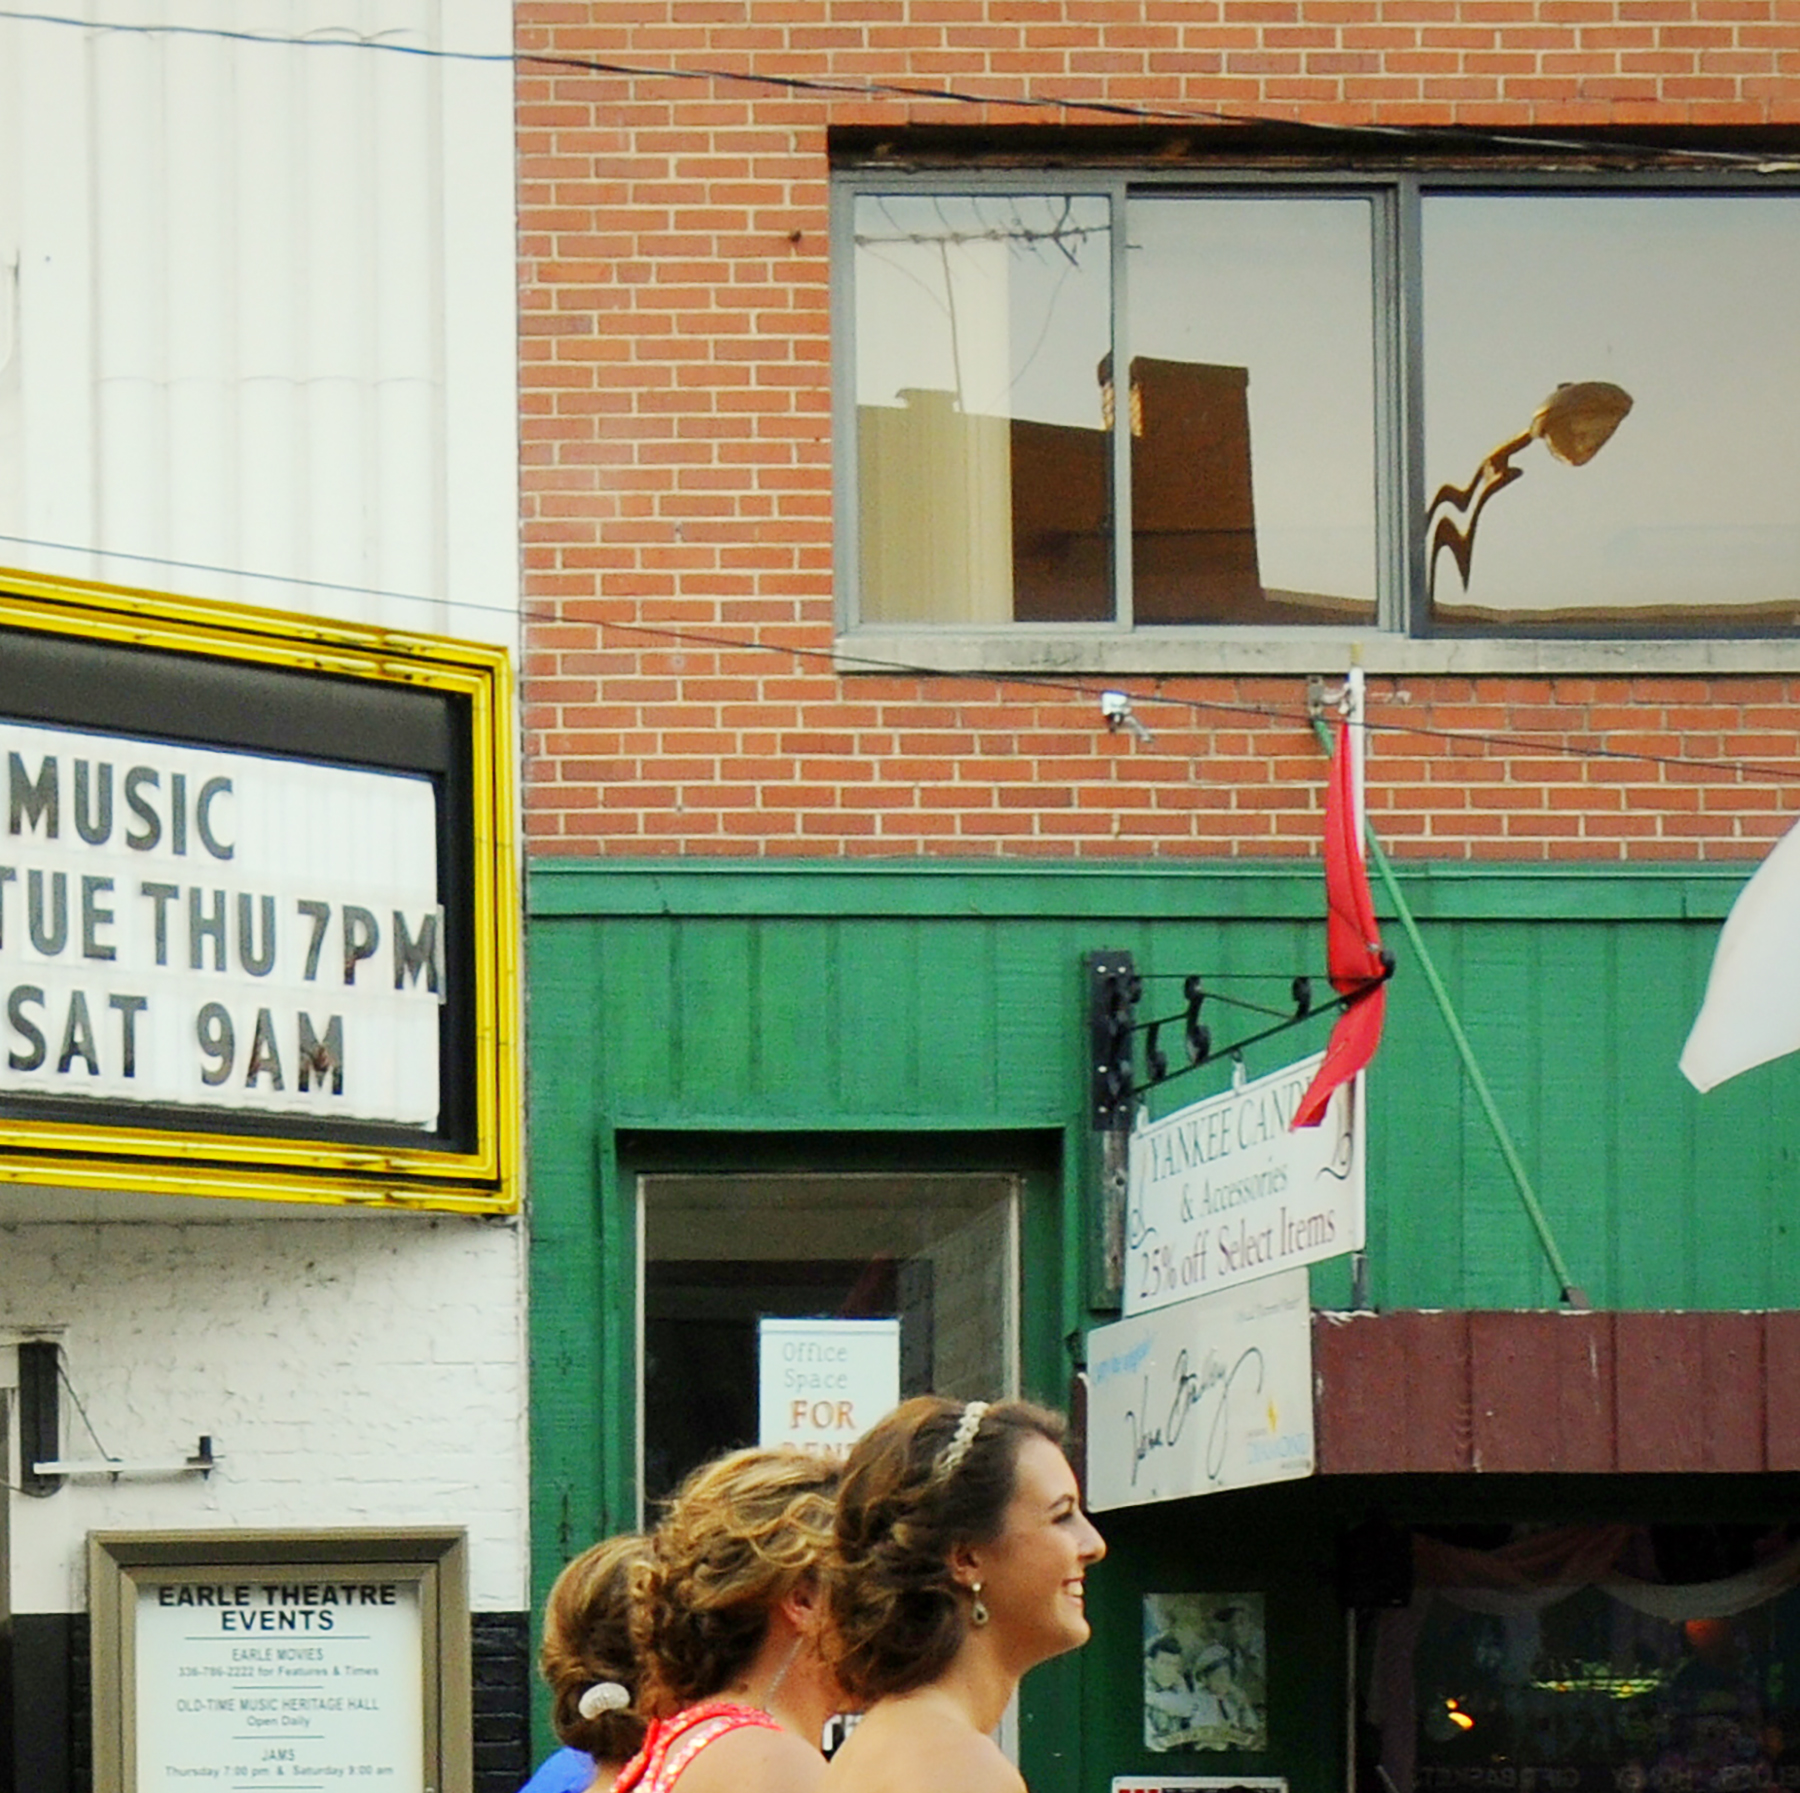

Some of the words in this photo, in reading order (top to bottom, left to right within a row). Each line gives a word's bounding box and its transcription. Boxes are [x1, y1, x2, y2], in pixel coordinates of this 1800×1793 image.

[10, 750, 235, 860] MUSIC
[140, 880, 277, 978] THU
[296, 899, 444, 995] 7PM
[8, 985, 148, 1079] SAT
[201, 1003, 345, 1097] 9AM
[1150, 1106, 1232, 1182] YANKEE
[1199, 1162, 1288, 1219] Accessories
[1182, 1232, 1210, 1286] off
[1217, 1219, 1274, 1278] Select
[1280, 1206, 1336, 1258] Items
[782, 1341, 849, 1363] Office
[784, 1368, 849, 1394] Space
[790, 1399, 856, 1430] FOR
[159, 1586, 250, 1606] EARLE
[262, 1585, 396, 1606] THEATRE
[221, 1610, 334, 1630] EVENTS
[232, 1648, 272, 1661] EARLE
[276, 1648, 324, 1661] MOVIES
[344, 1665, 379, 1676] Times
[177, 1699, 234, 1712] OLD-TIME
[240, 1699, 278, 1712] MUSIC
[282, 1698, 343, 1711] HERITAGE
[347, 1698, 379, 1711] HALL
[247, 1716, 278, 1729] Open
[281, 1715, 311, 1729] Daily
[261, 1749, 295, 1762] JAMS
[293, 1765, 344, 1777] Saturday
